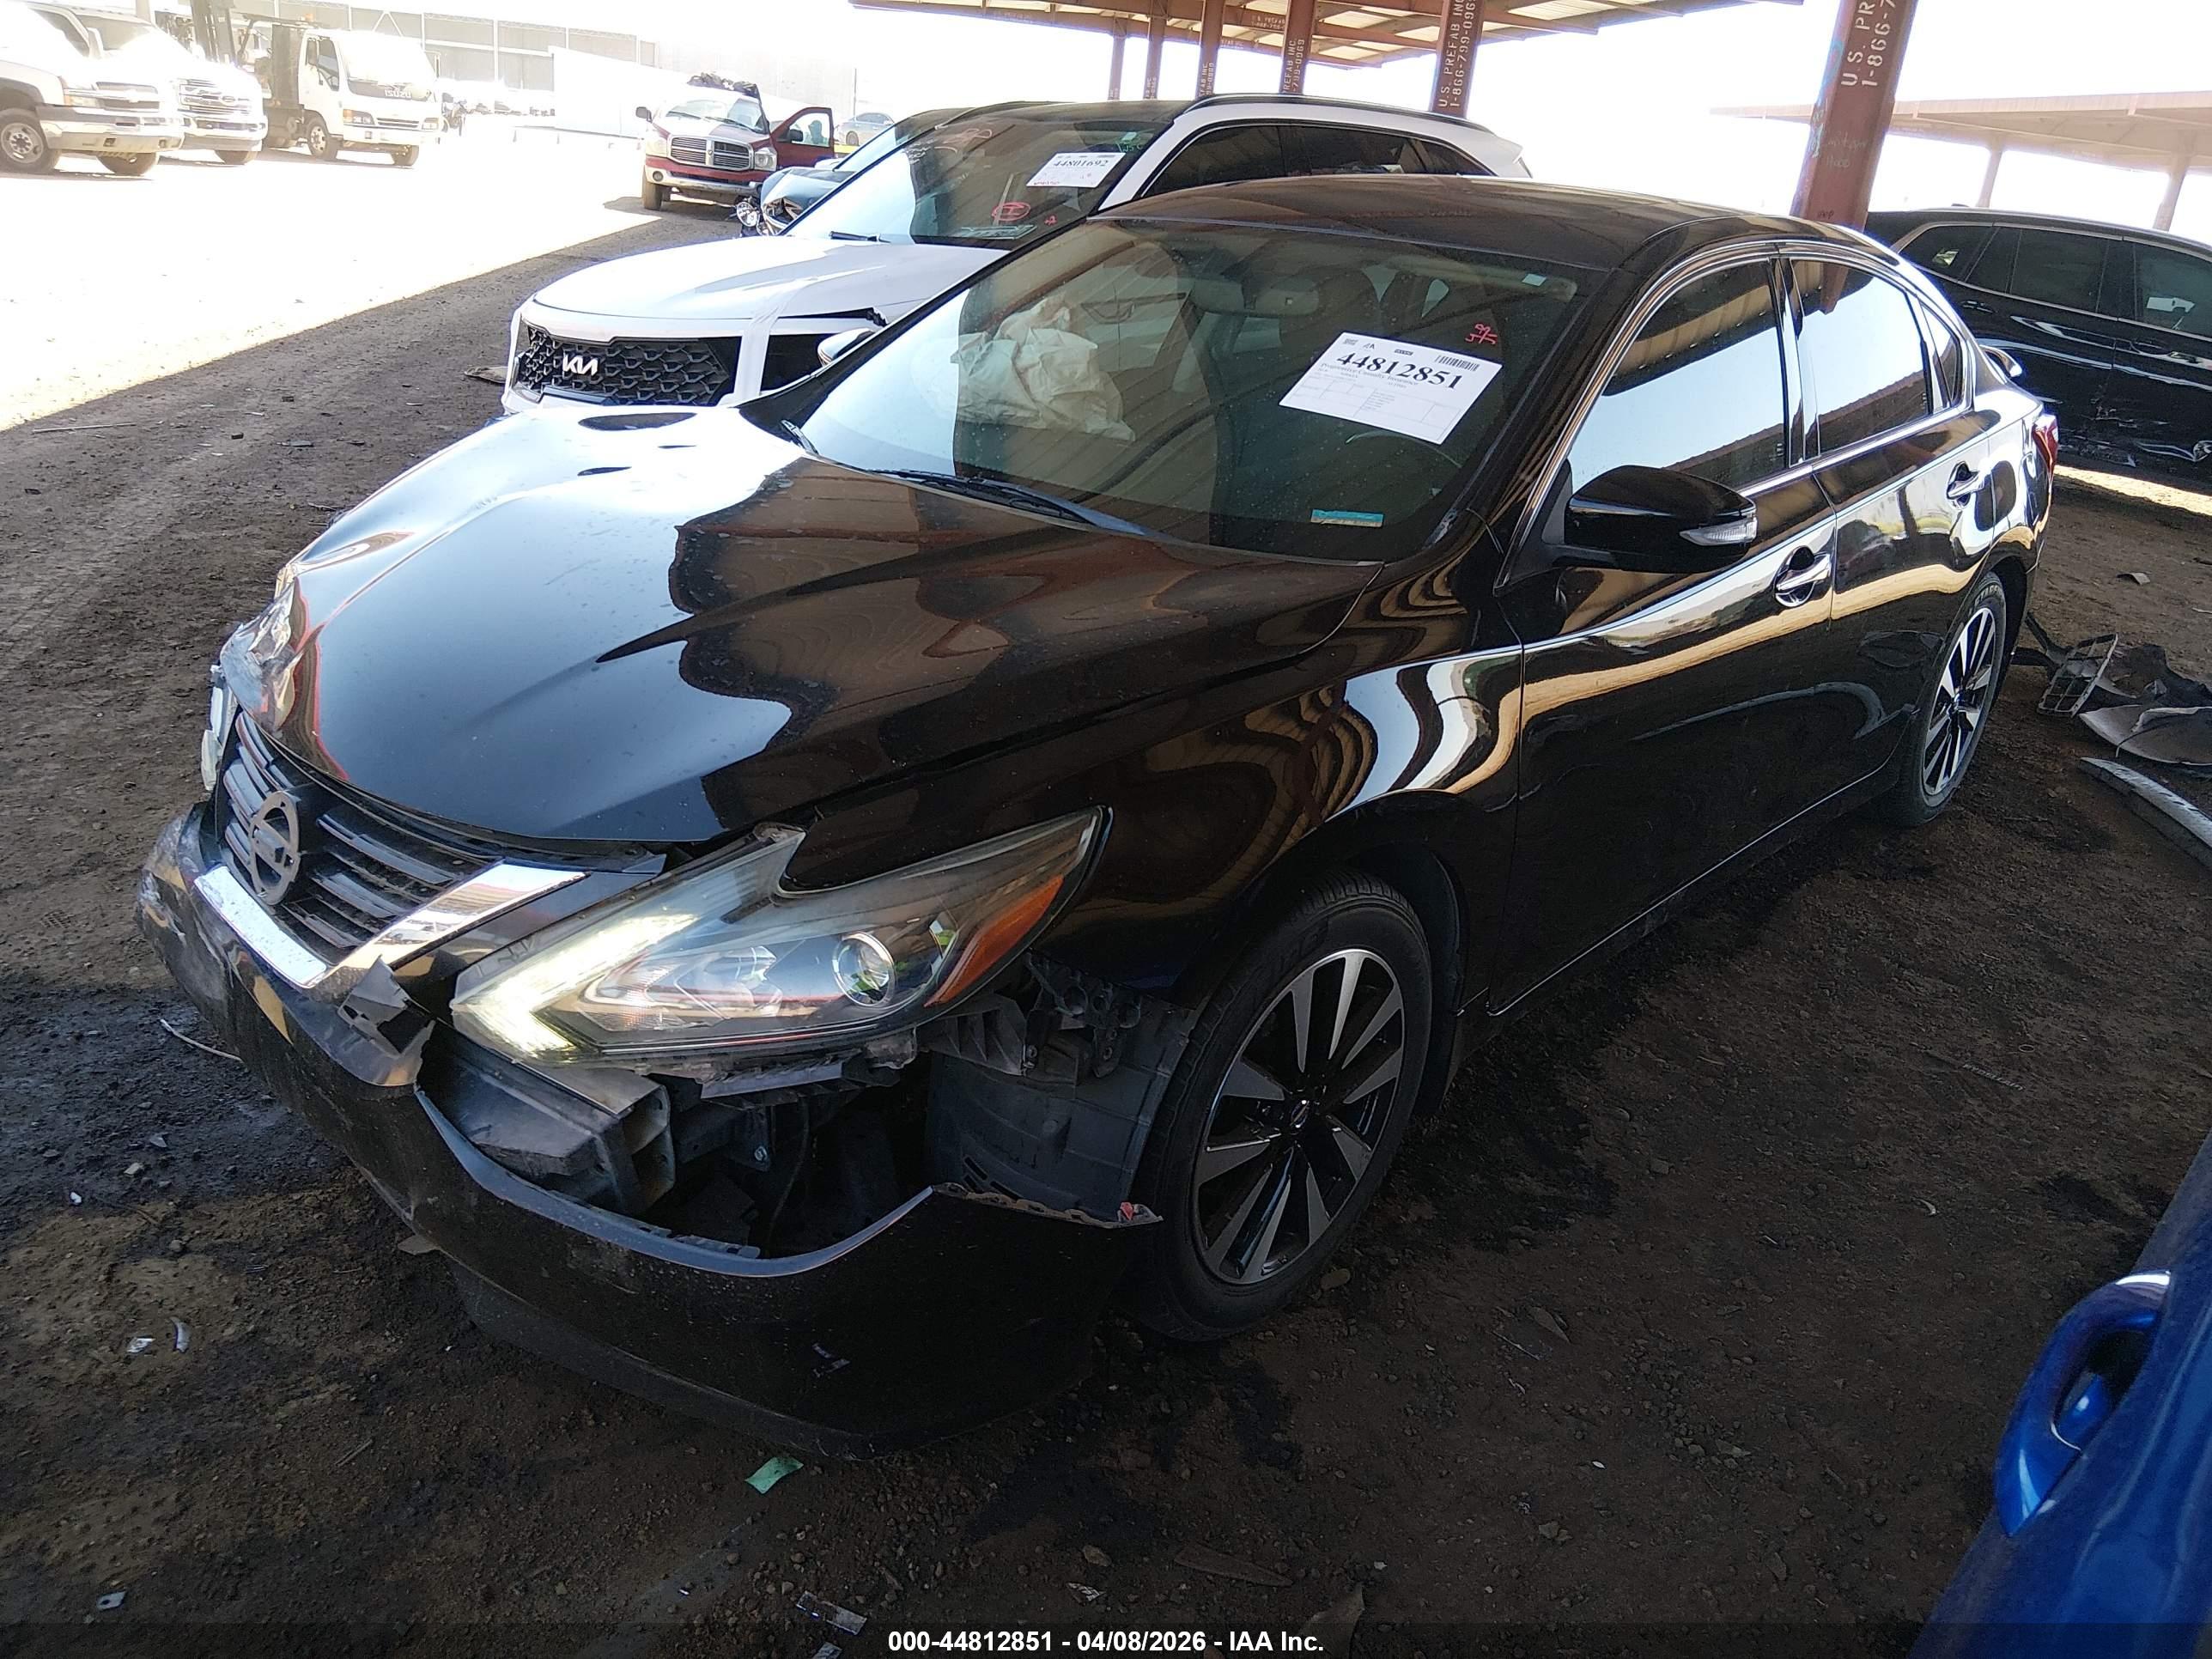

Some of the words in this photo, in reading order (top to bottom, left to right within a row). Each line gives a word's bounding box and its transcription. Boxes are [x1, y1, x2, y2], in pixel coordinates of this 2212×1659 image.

[1443, 23, 1461, 75] PREFAB
[1449, 0, 1476, 106] 1-866-799-096
[385, 89, 412, 99] ISUZU
[1336, 352, 1462, 389] 44812851
